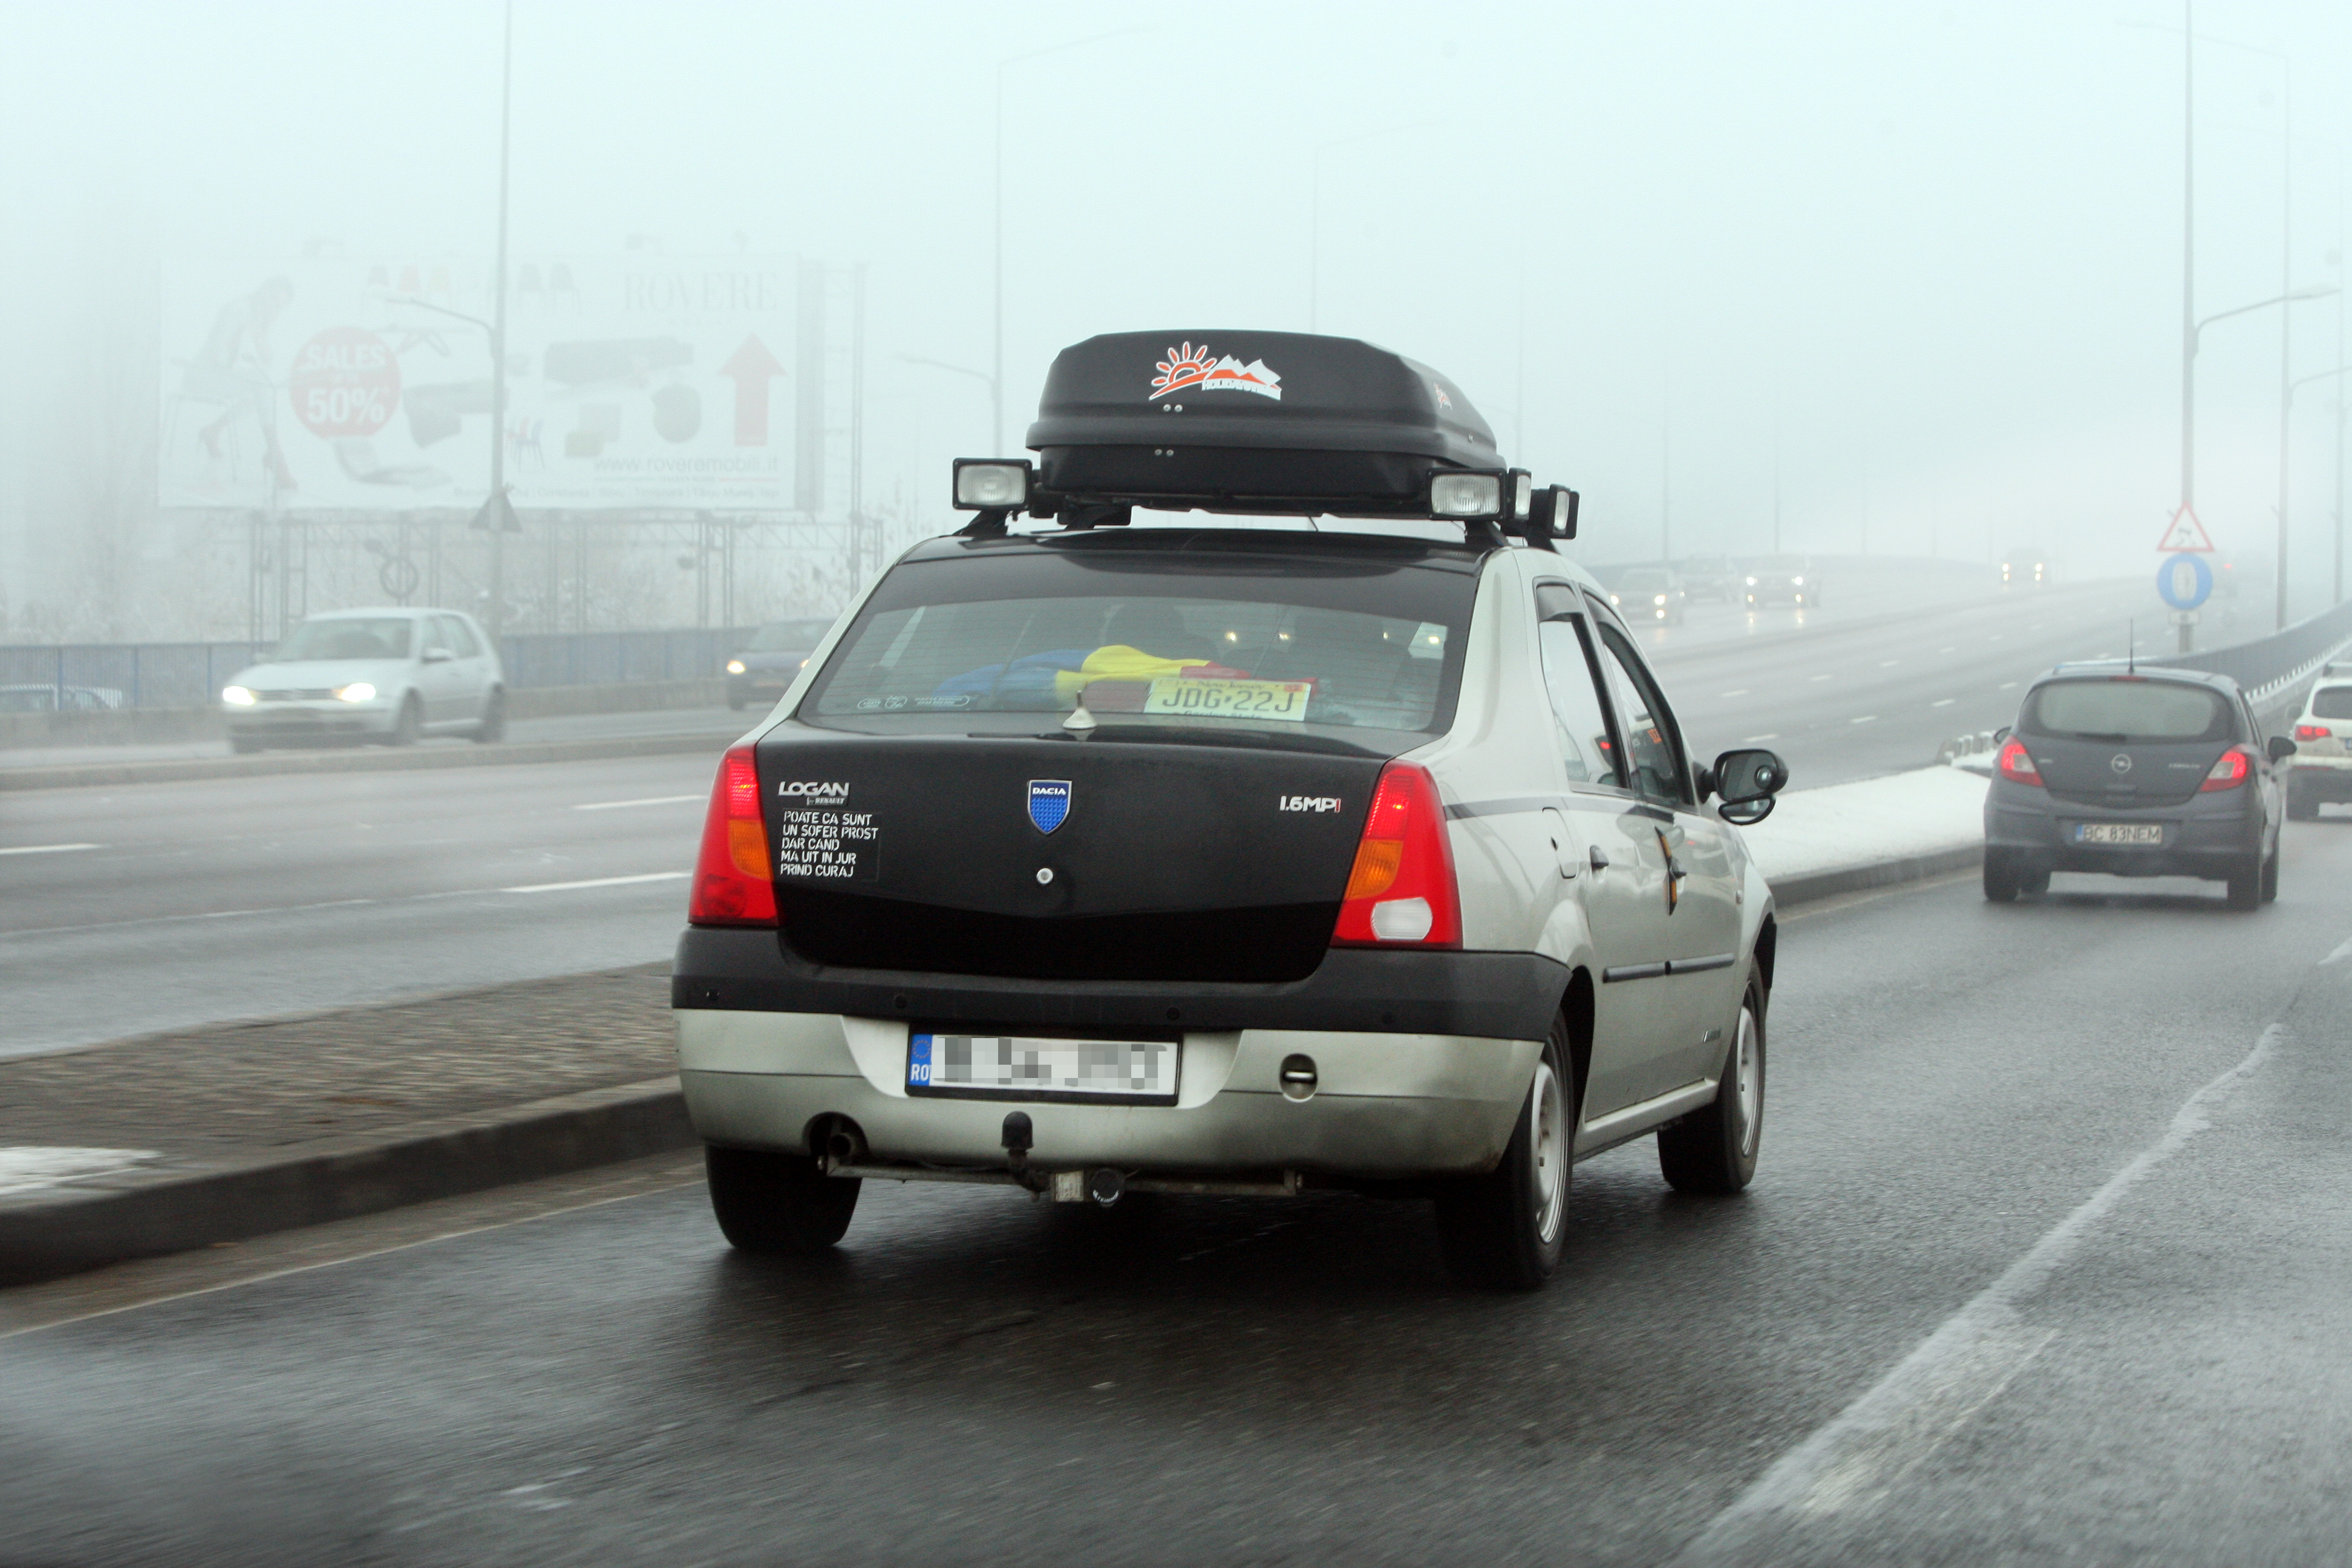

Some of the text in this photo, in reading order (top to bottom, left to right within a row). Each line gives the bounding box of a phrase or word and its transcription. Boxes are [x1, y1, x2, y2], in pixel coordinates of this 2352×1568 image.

[623, 271, 779, 312] ROVERE
[306, 344, 387, 370] SALES
[595, 454, 779, 472] www.roveremobili.it
[778, 781, 849, 796] LOGAN
[1032, 787, 1067, 795] DACIA
[783, 811, 872, 826] POATE CA SUNT
[783, 825, 878, 840] UN SOFER PROST
[2085, 826, 2103, 841] BC
[782, 837, 840, 851] DAR CAND
[780, 850, 857, 864] MA UIT IN JUR
[780, 863, 854, 878] PRIND CURAJ
[910, 1063, 929, 1082] RO
